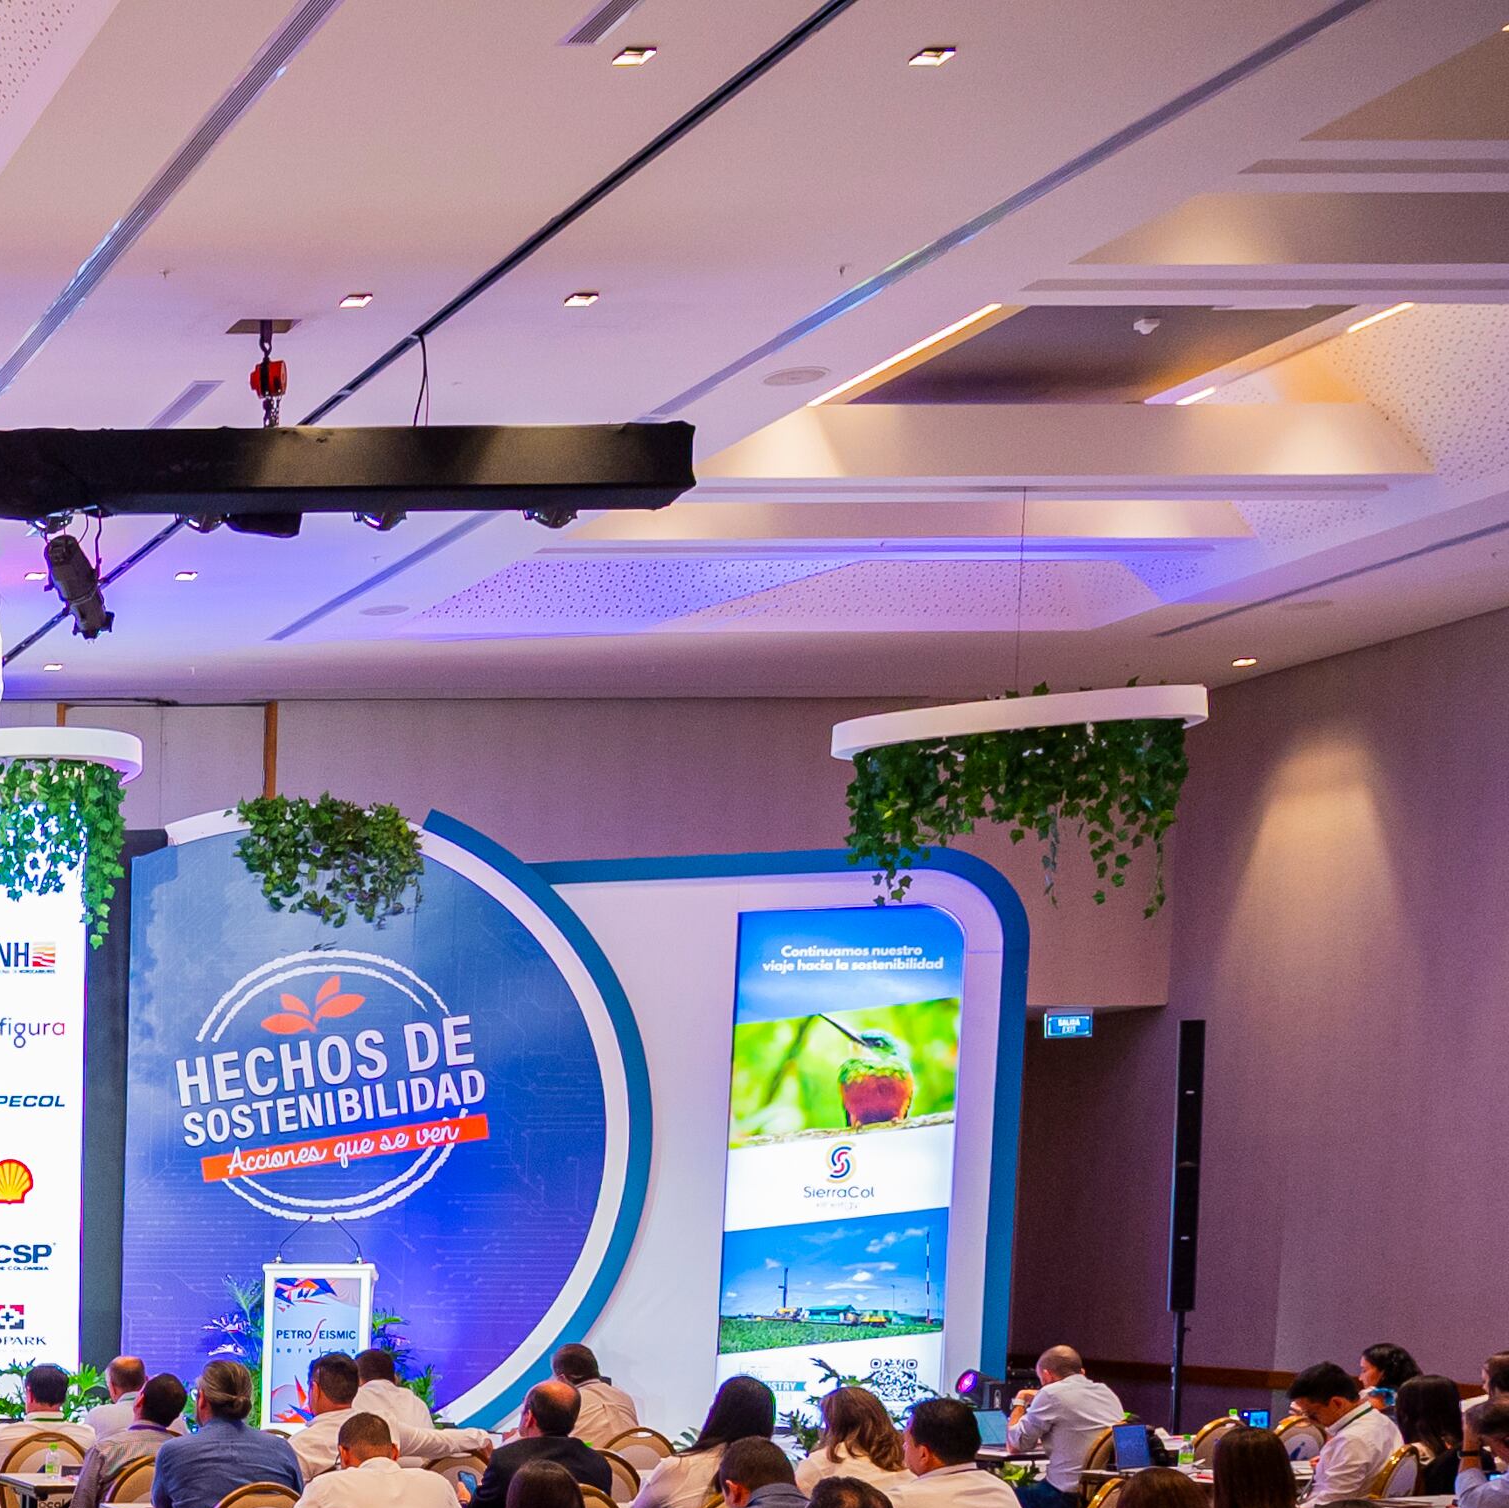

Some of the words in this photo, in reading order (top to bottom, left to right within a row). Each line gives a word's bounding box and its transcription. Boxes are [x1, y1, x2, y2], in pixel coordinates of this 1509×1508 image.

[762, 959, 795, 974] viaje
[797, 959, 833, 971] hacia
[835, 958, 849, 971] la
[851, 957, 944, 971] sostenibilidad
[781, 945, 870, 958] Continuamos
[872, 945, 923, 957] nuestro
[175, 1029, 389, 1107] HECHOS
[403, 1014, 475, 1073] DE
[183, 1069, 486, 1147] SOSTENIBILIDAD
[227, 1146, 328, 1175] Acciones
[334, 1138, 376, 1168] que
[379, 1134, 409, 1151] se
[416, 1124, 460, 1144] ven
[803, 1186, 875, 1199] SierraCol
